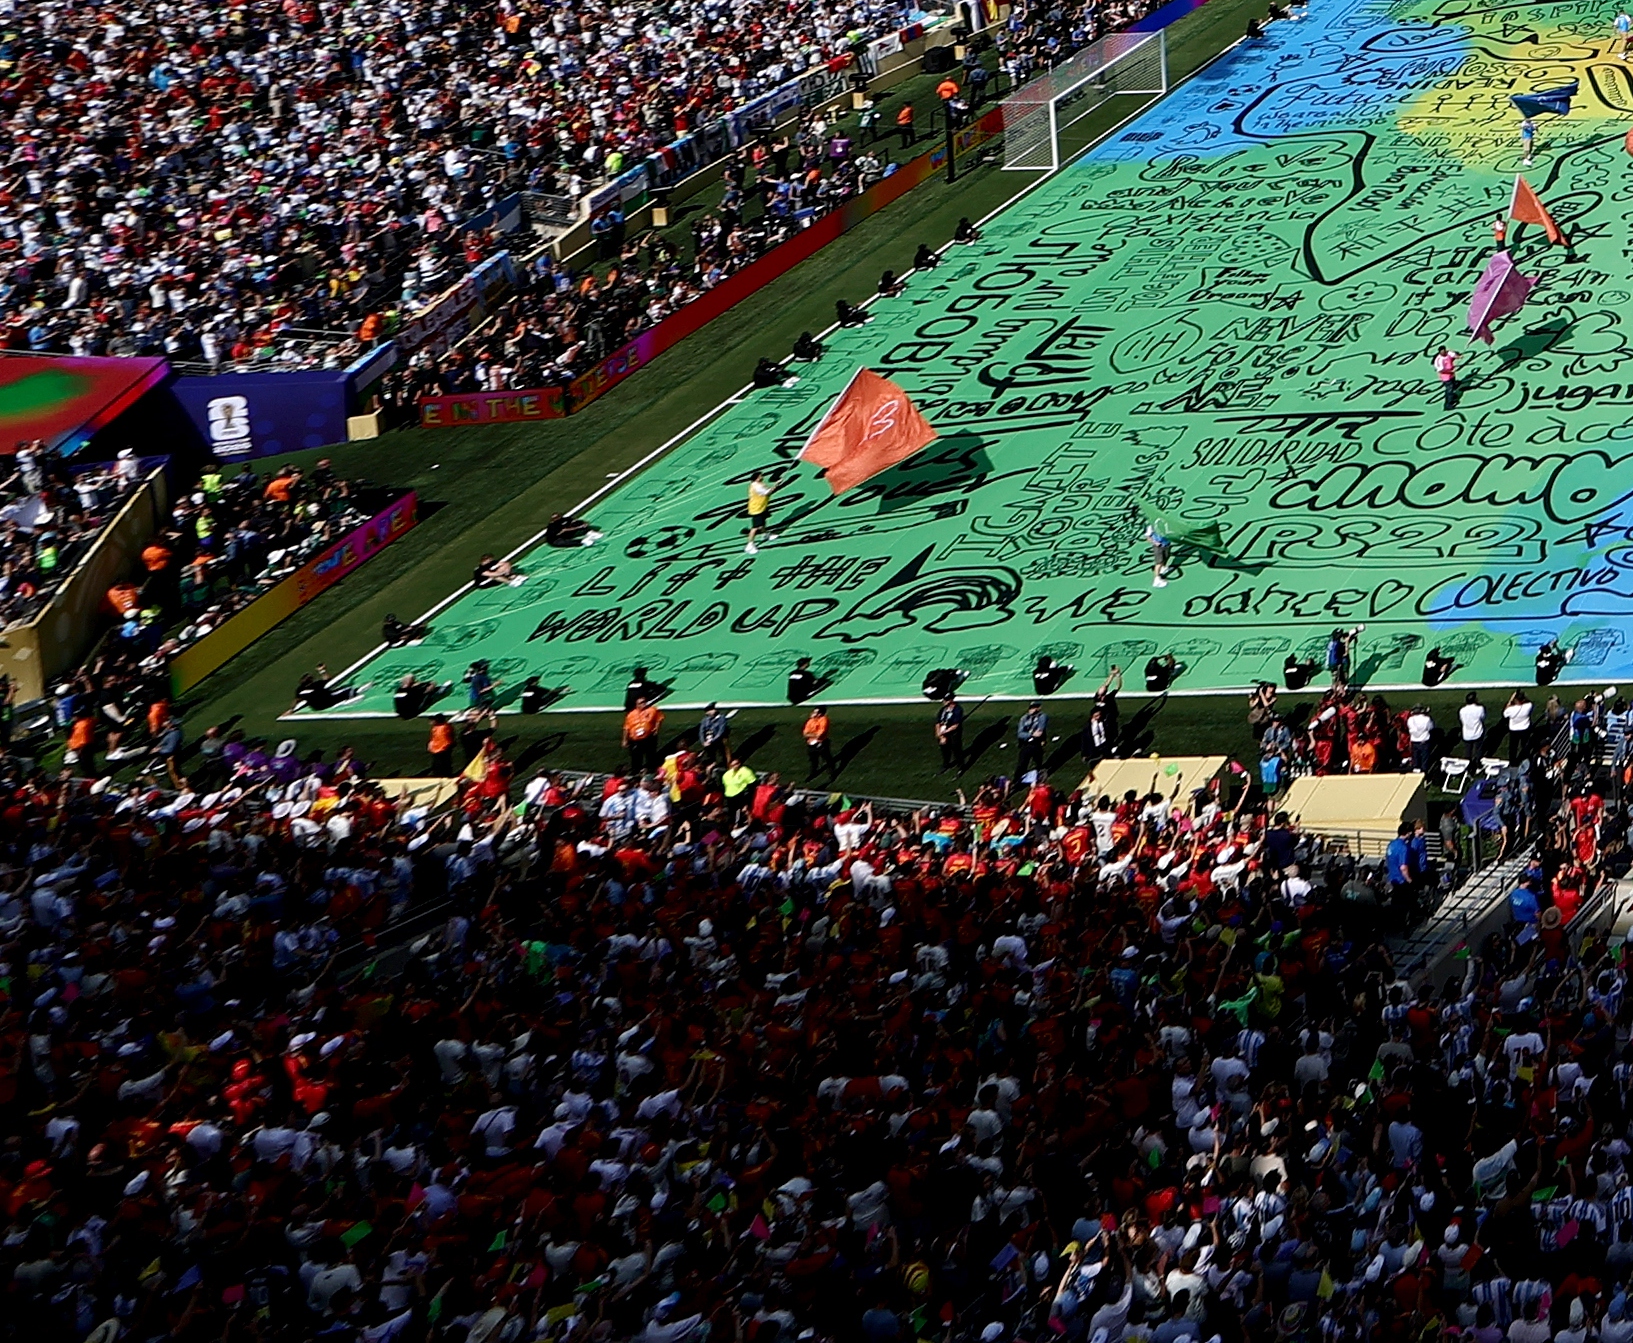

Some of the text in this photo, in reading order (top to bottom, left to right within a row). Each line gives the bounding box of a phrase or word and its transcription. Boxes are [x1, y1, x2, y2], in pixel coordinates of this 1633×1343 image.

[1209, 311, 1376, 342] NEVER
[486, 395, 542, 418] THE
[1177, 435, 1364, 469] SOLIDARIDAD
[526, 598, 729, 644] WORLD
